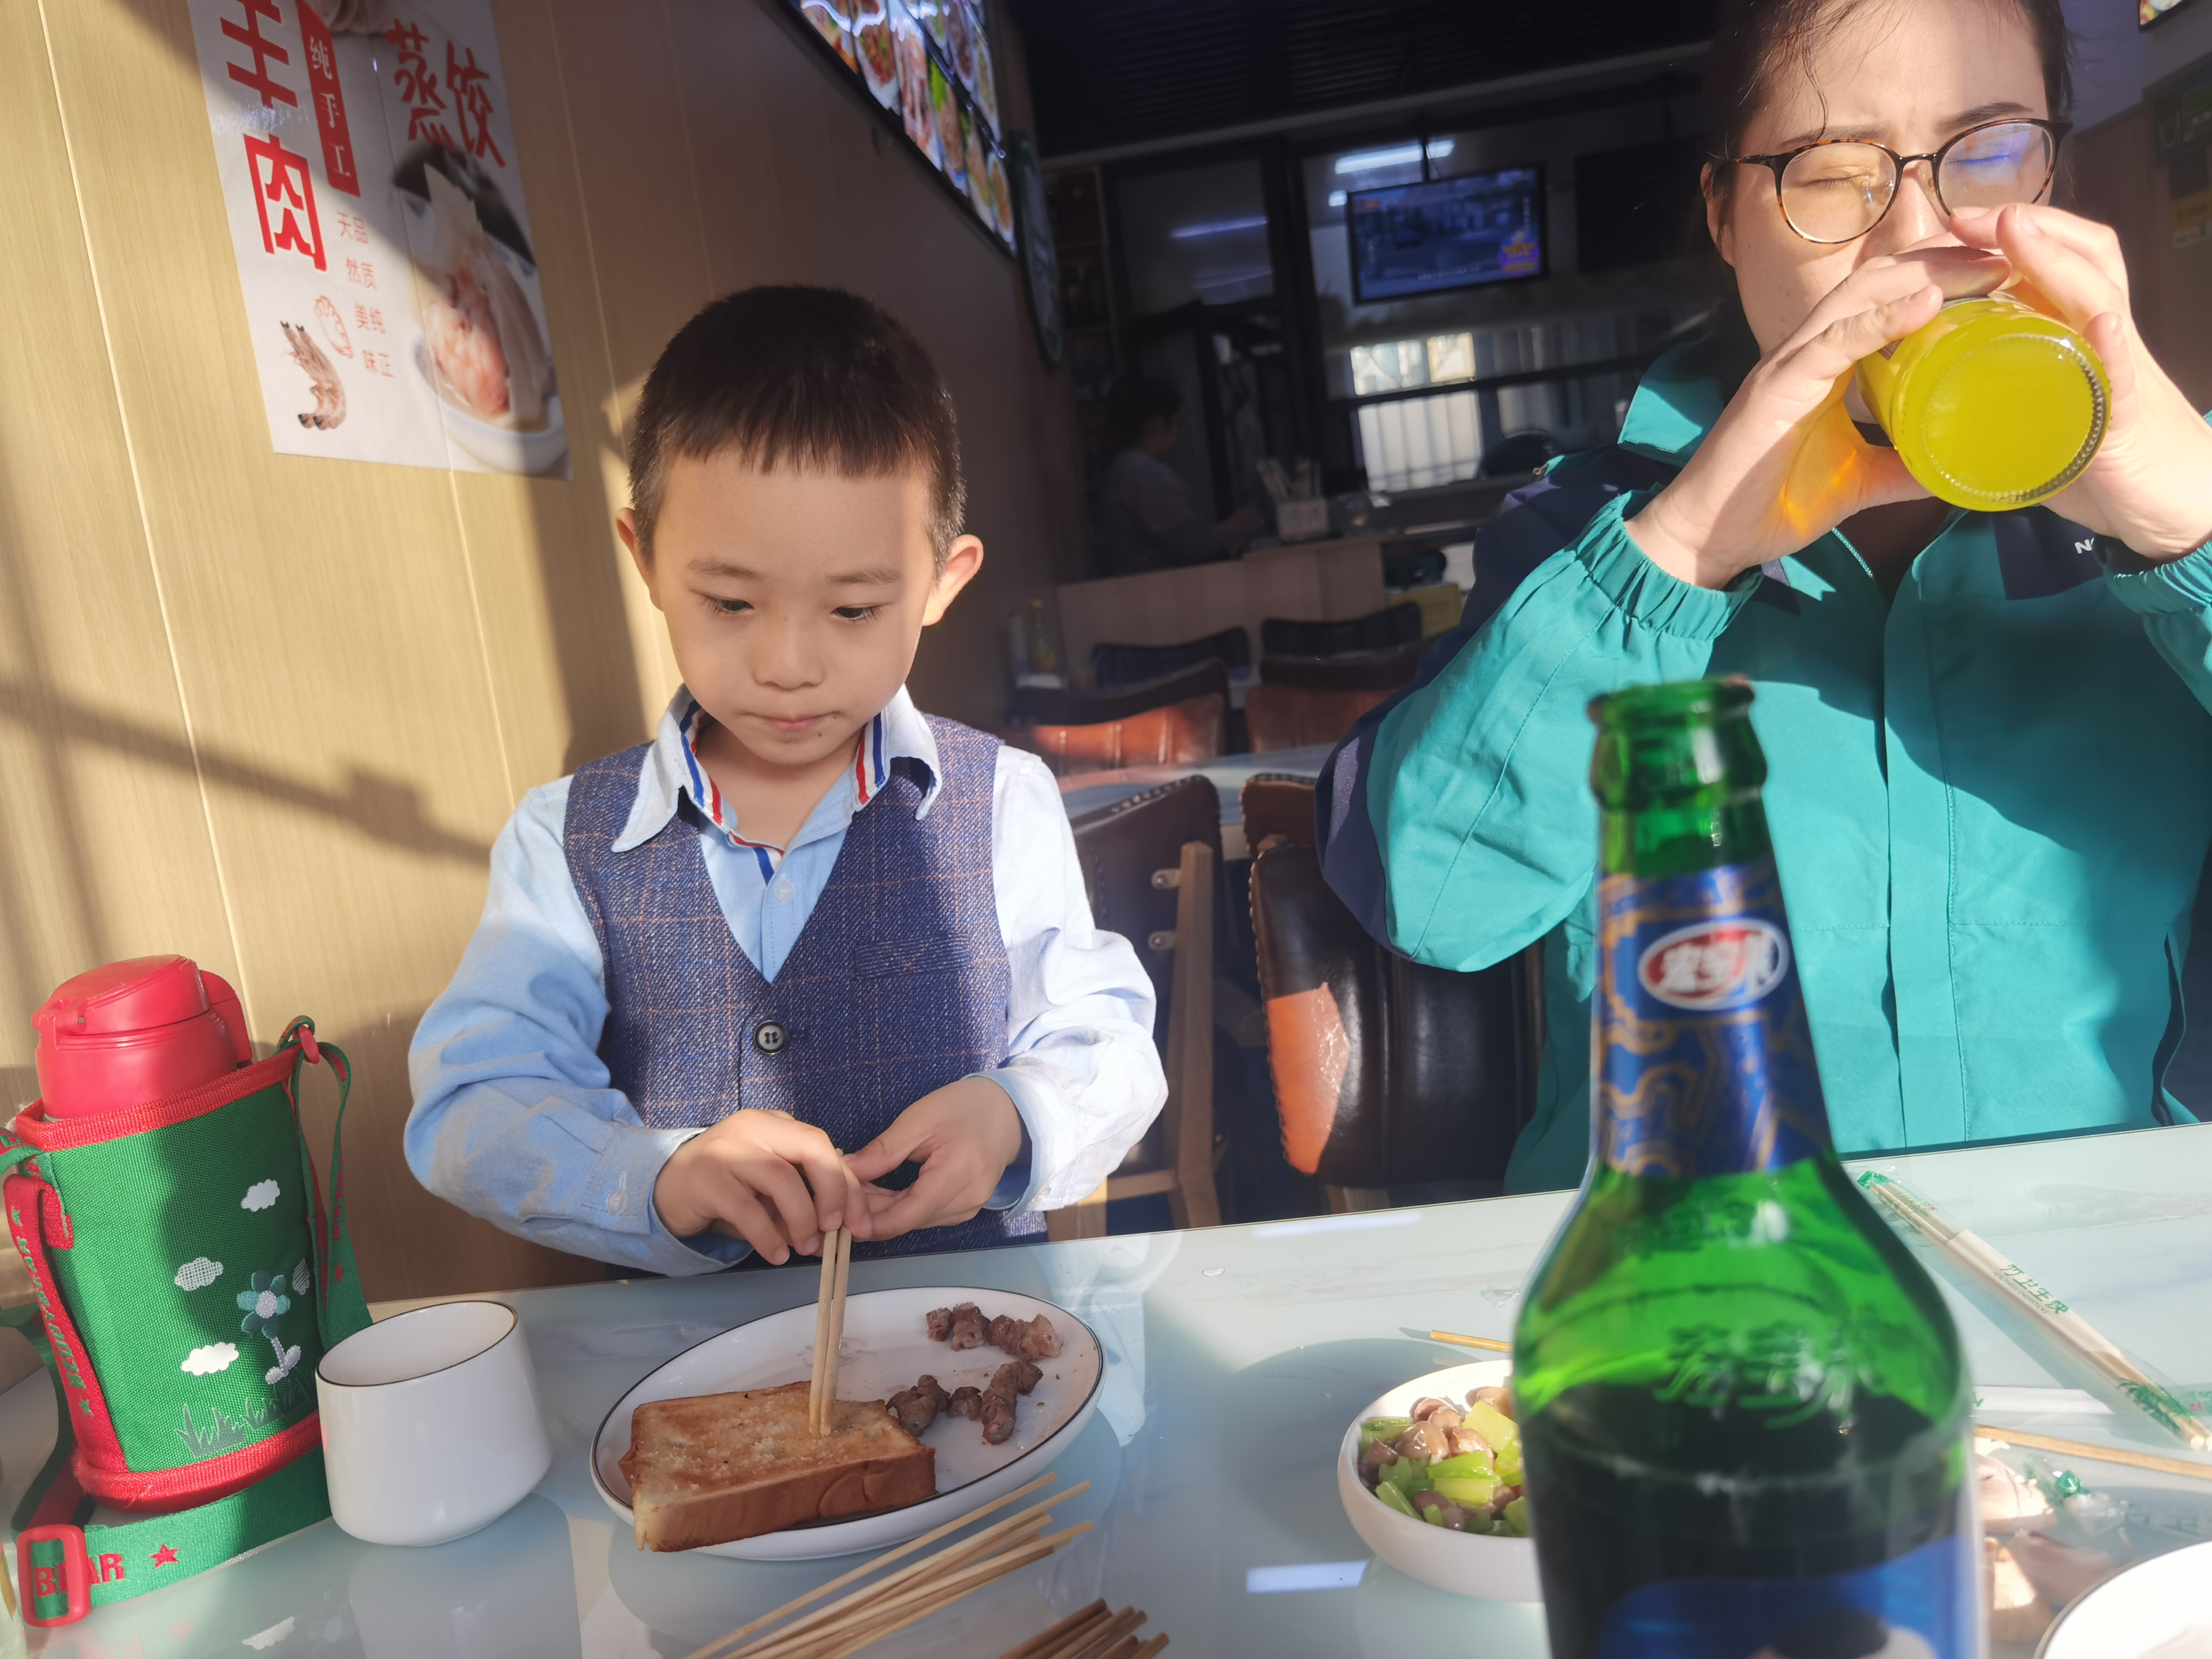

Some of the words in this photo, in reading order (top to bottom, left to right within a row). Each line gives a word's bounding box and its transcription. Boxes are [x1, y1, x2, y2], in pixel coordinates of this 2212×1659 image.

[310, 36, 352, 178] 纯手工
[386, 18, 506, 168] 蒸饺
[2074, 537, 2095, 554] N
